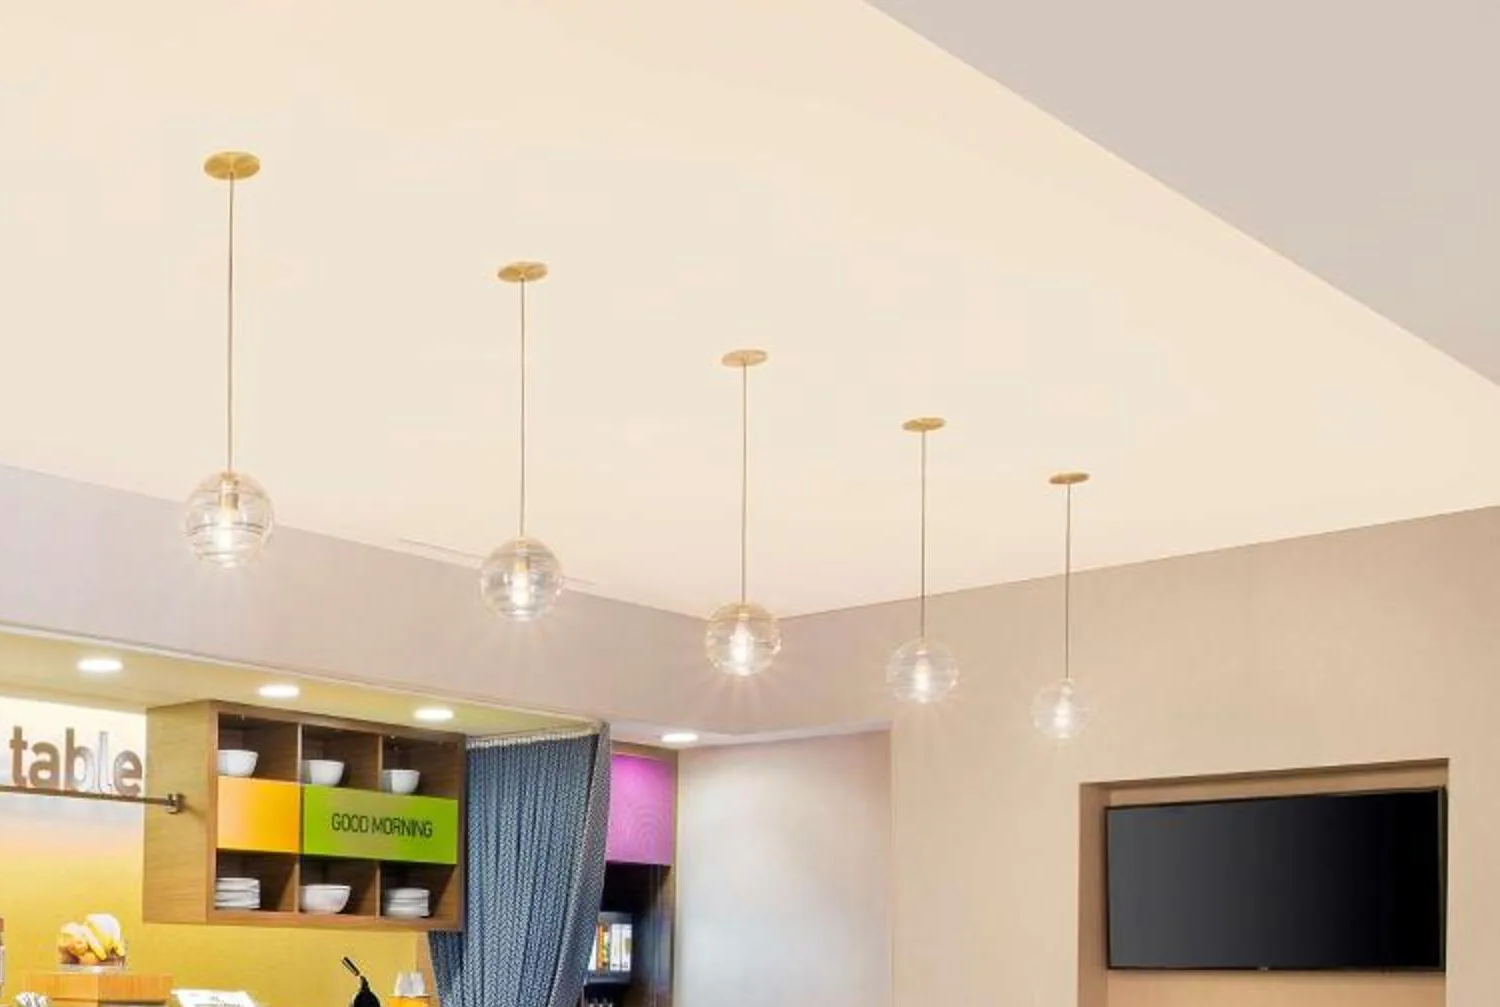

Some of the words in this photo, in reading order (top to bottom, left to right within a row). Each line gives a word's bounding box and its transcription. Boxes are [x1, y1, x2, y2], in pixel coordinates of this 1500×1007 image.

[9, 725, 143, 796] table
[331, 813, 368, 833] GOOD
[371, 815, 434, 838] MORNING
